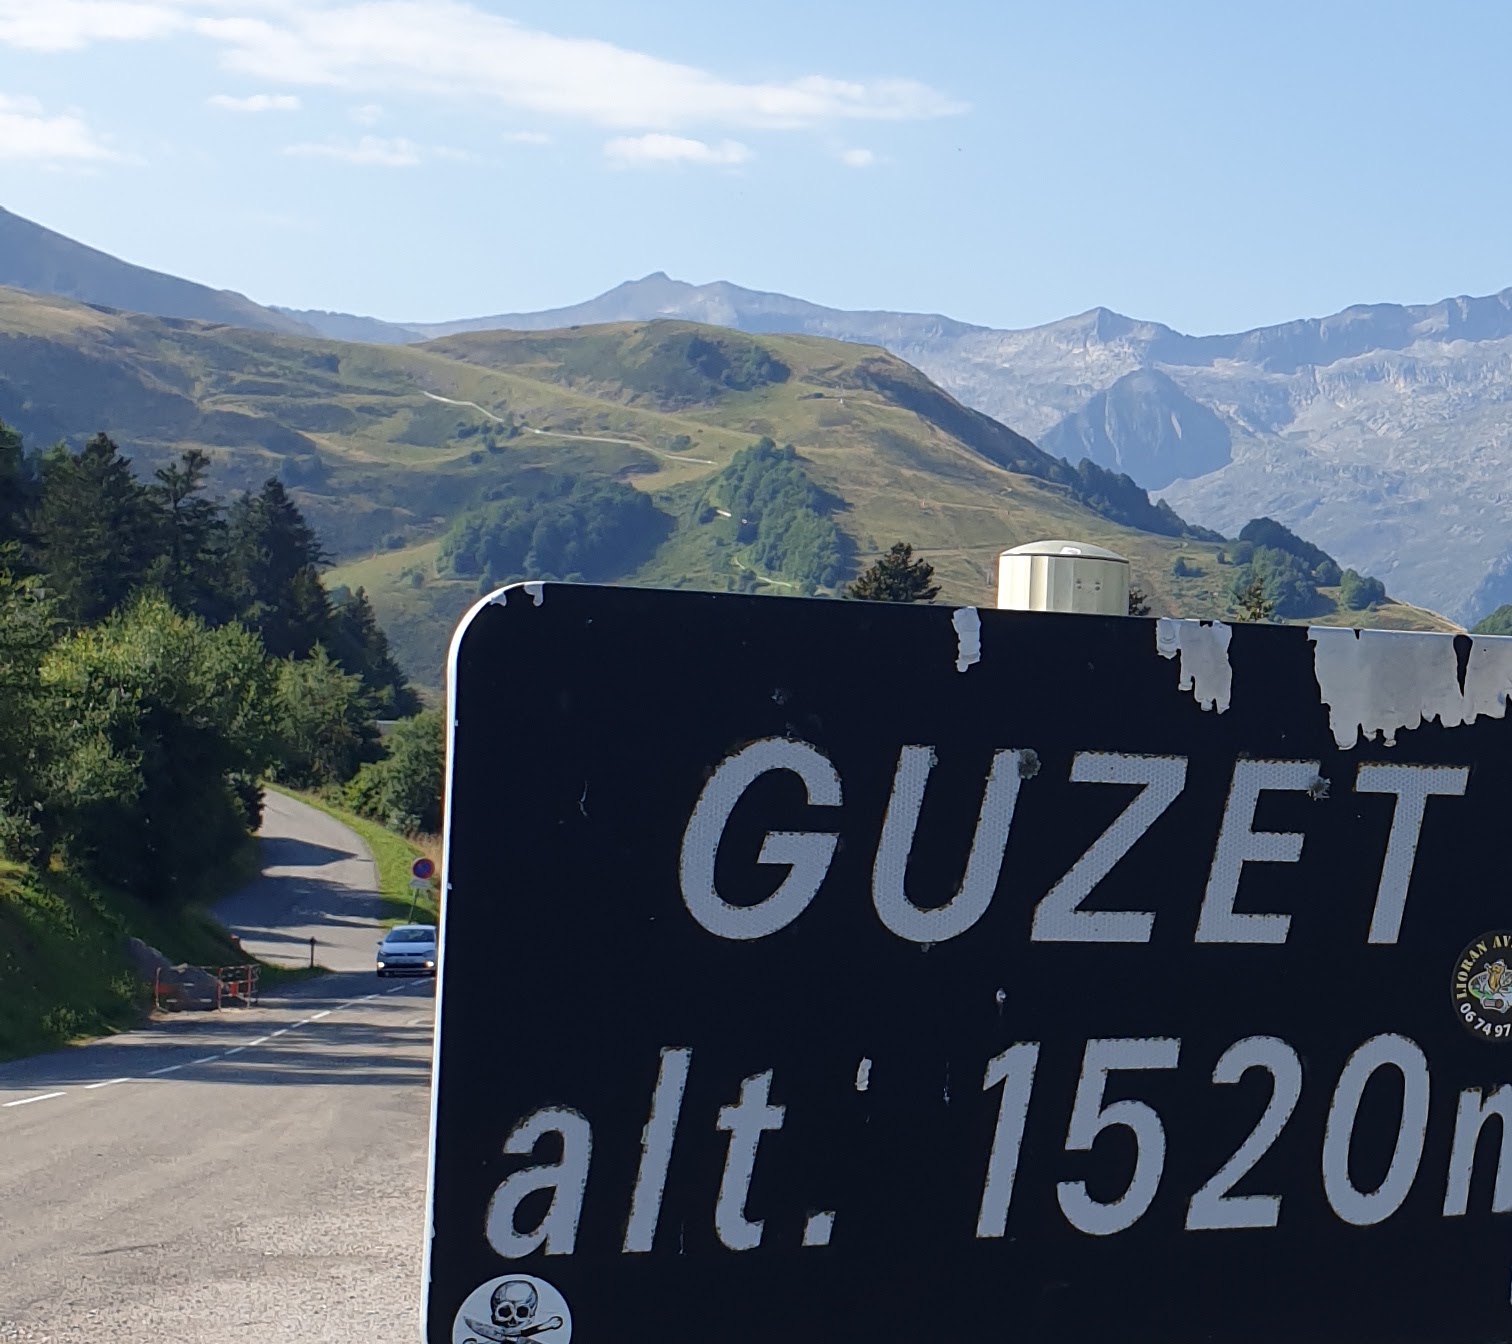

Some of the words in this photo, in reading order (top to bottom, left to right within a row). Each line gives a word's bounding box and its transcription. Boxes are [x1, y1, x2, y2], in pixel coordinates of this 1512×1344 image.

[678, 734, 1471, 946] GUZET
[1456, 941, 1488, 1000] LIORAN
[1460, 1002, 1477, 1023] 06
[1474, 1018, 1492, 1036] 74
[1494, 1024, 1511, 1037] 97
[485, 1047, 835, 1257] alt.
